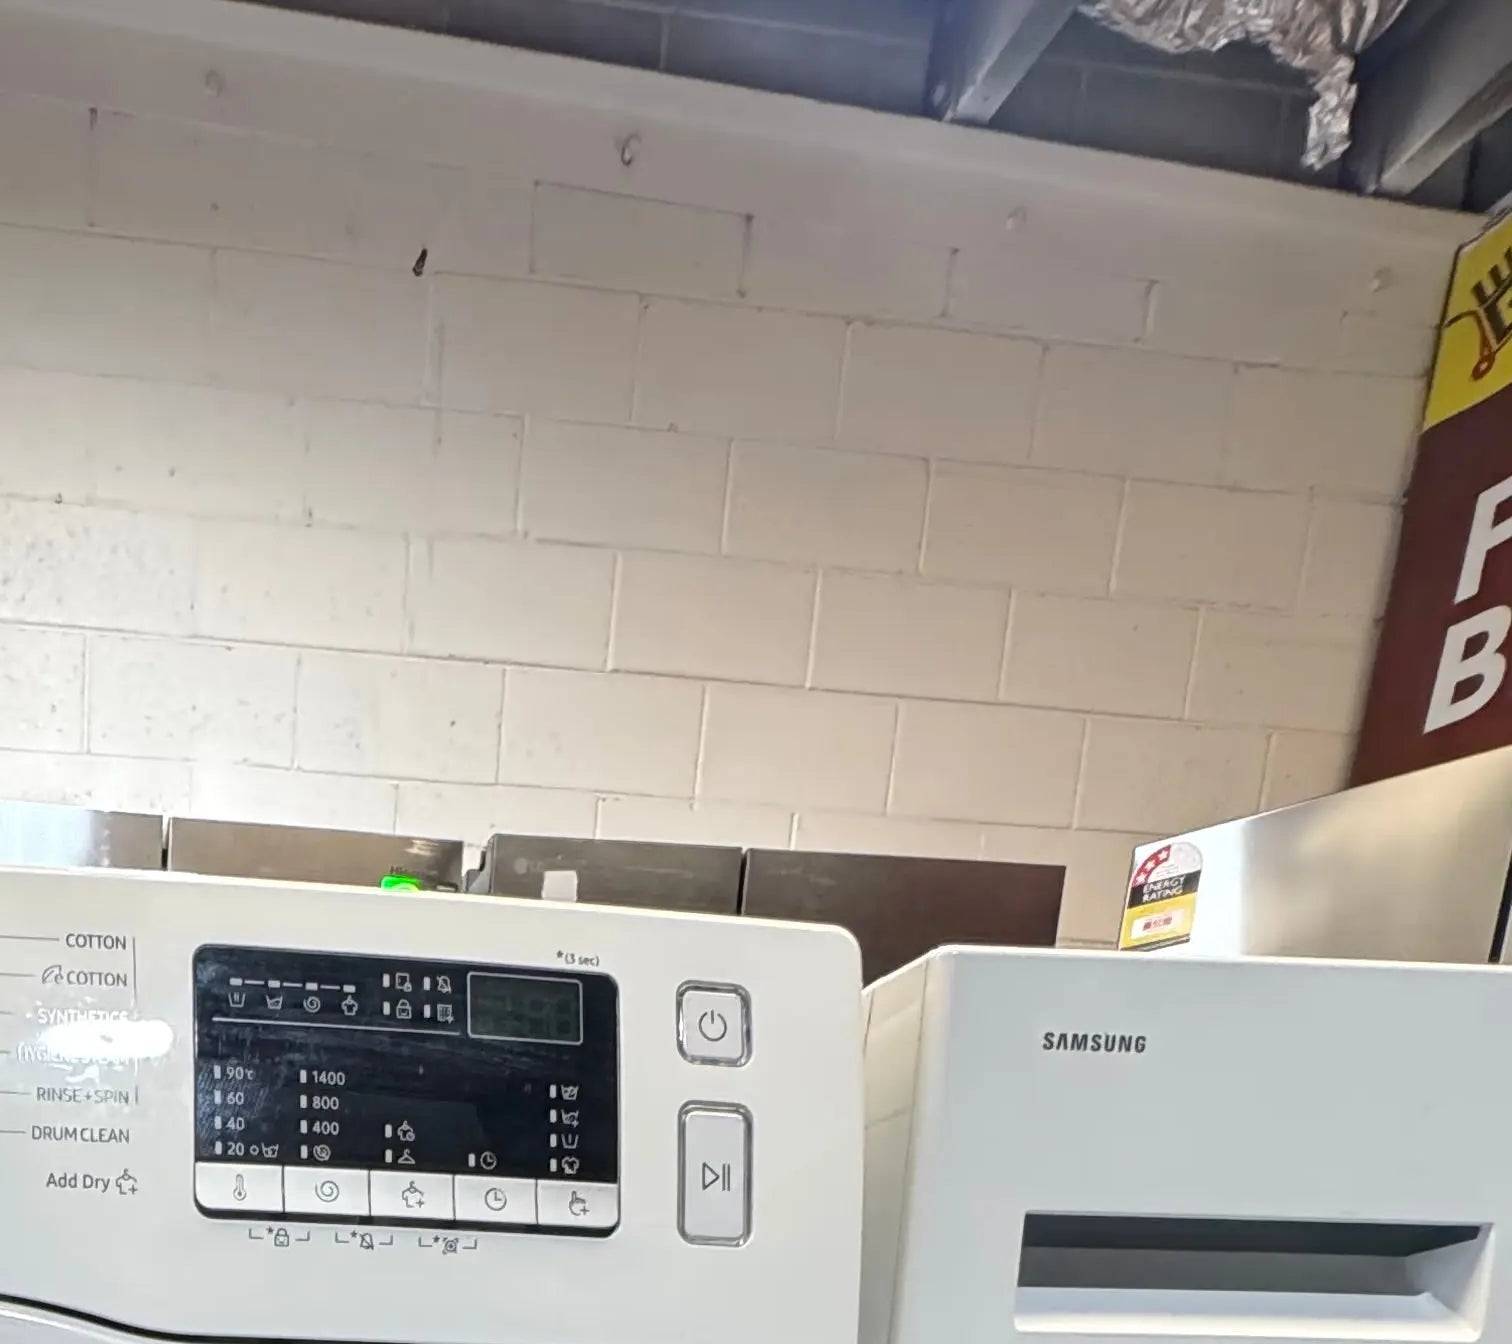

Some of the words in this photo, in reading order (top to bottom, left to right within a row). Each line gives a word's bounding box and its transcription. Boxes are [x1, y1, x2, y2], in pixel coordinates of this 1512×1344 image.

[1143, 875, 1185, 894] ENERGY
[1142, 886, 1183, 903] RATING
[65, 933, 127, 950] COTTON
[66, 970, 128, 987] COTTON
[1042, 1032, 1146, 1053] SAMSUNG
[312, 1070, 346, 1086] 1400
[227, 1092, 244, 1105] 60
[312, 1096, 339, 1110] 800
[226, 1117, 245, 1131] 40
[312, 1121, 339, 1136] 400
[31, 1125, 77, 1142] DRUM
[80, 1127, 130, 1144] CLEAN
[226, 1143, 244, 1156] 20
[46, 1172, 77, 1188] Add
[82, 1174, 110, 1193] Dry
